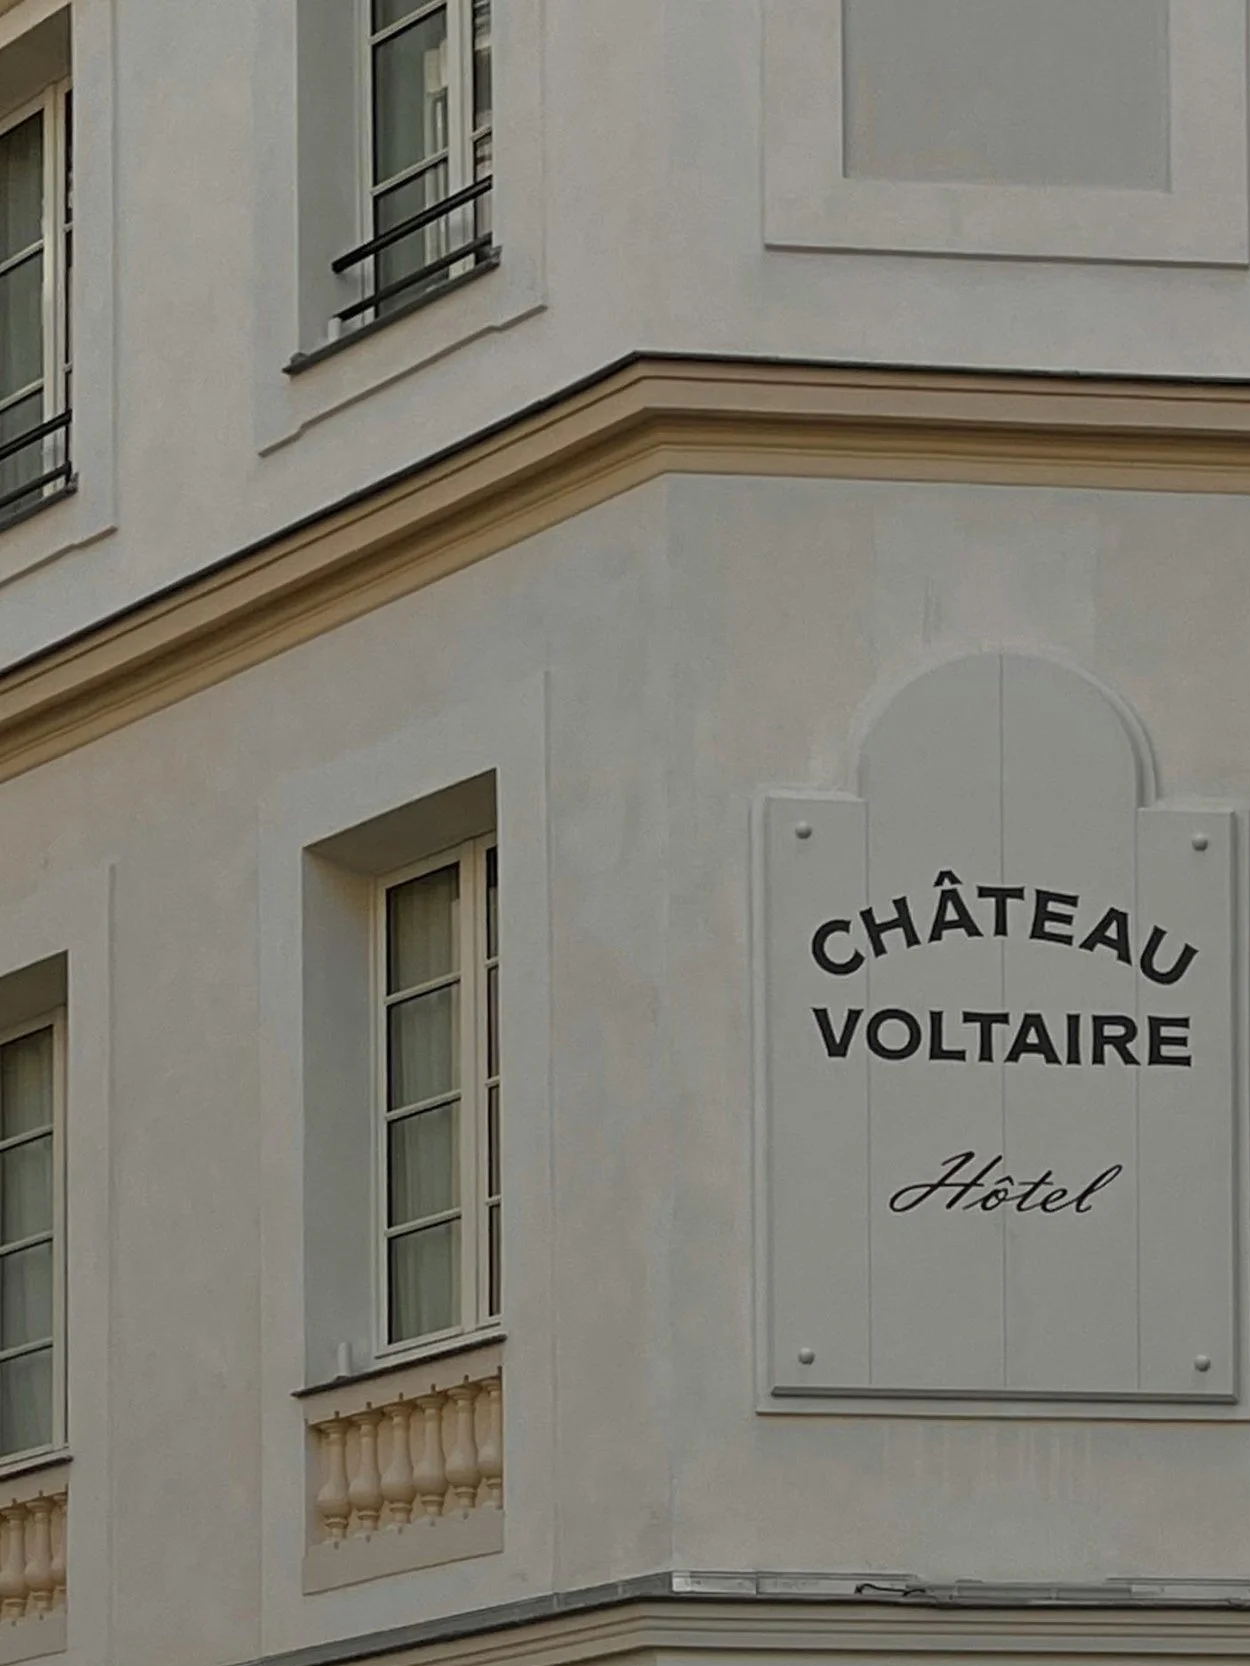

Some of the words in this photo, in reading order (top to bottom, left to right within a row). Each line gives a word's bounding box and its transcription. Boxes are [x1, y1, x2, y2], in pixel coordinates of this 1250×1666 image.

[810, 870, 1199, 986] CHÂTEAU
[812, 1007, 1193, 1068] VOLTAIRE
[889, 1150, 1124, 1215] Hôtel
